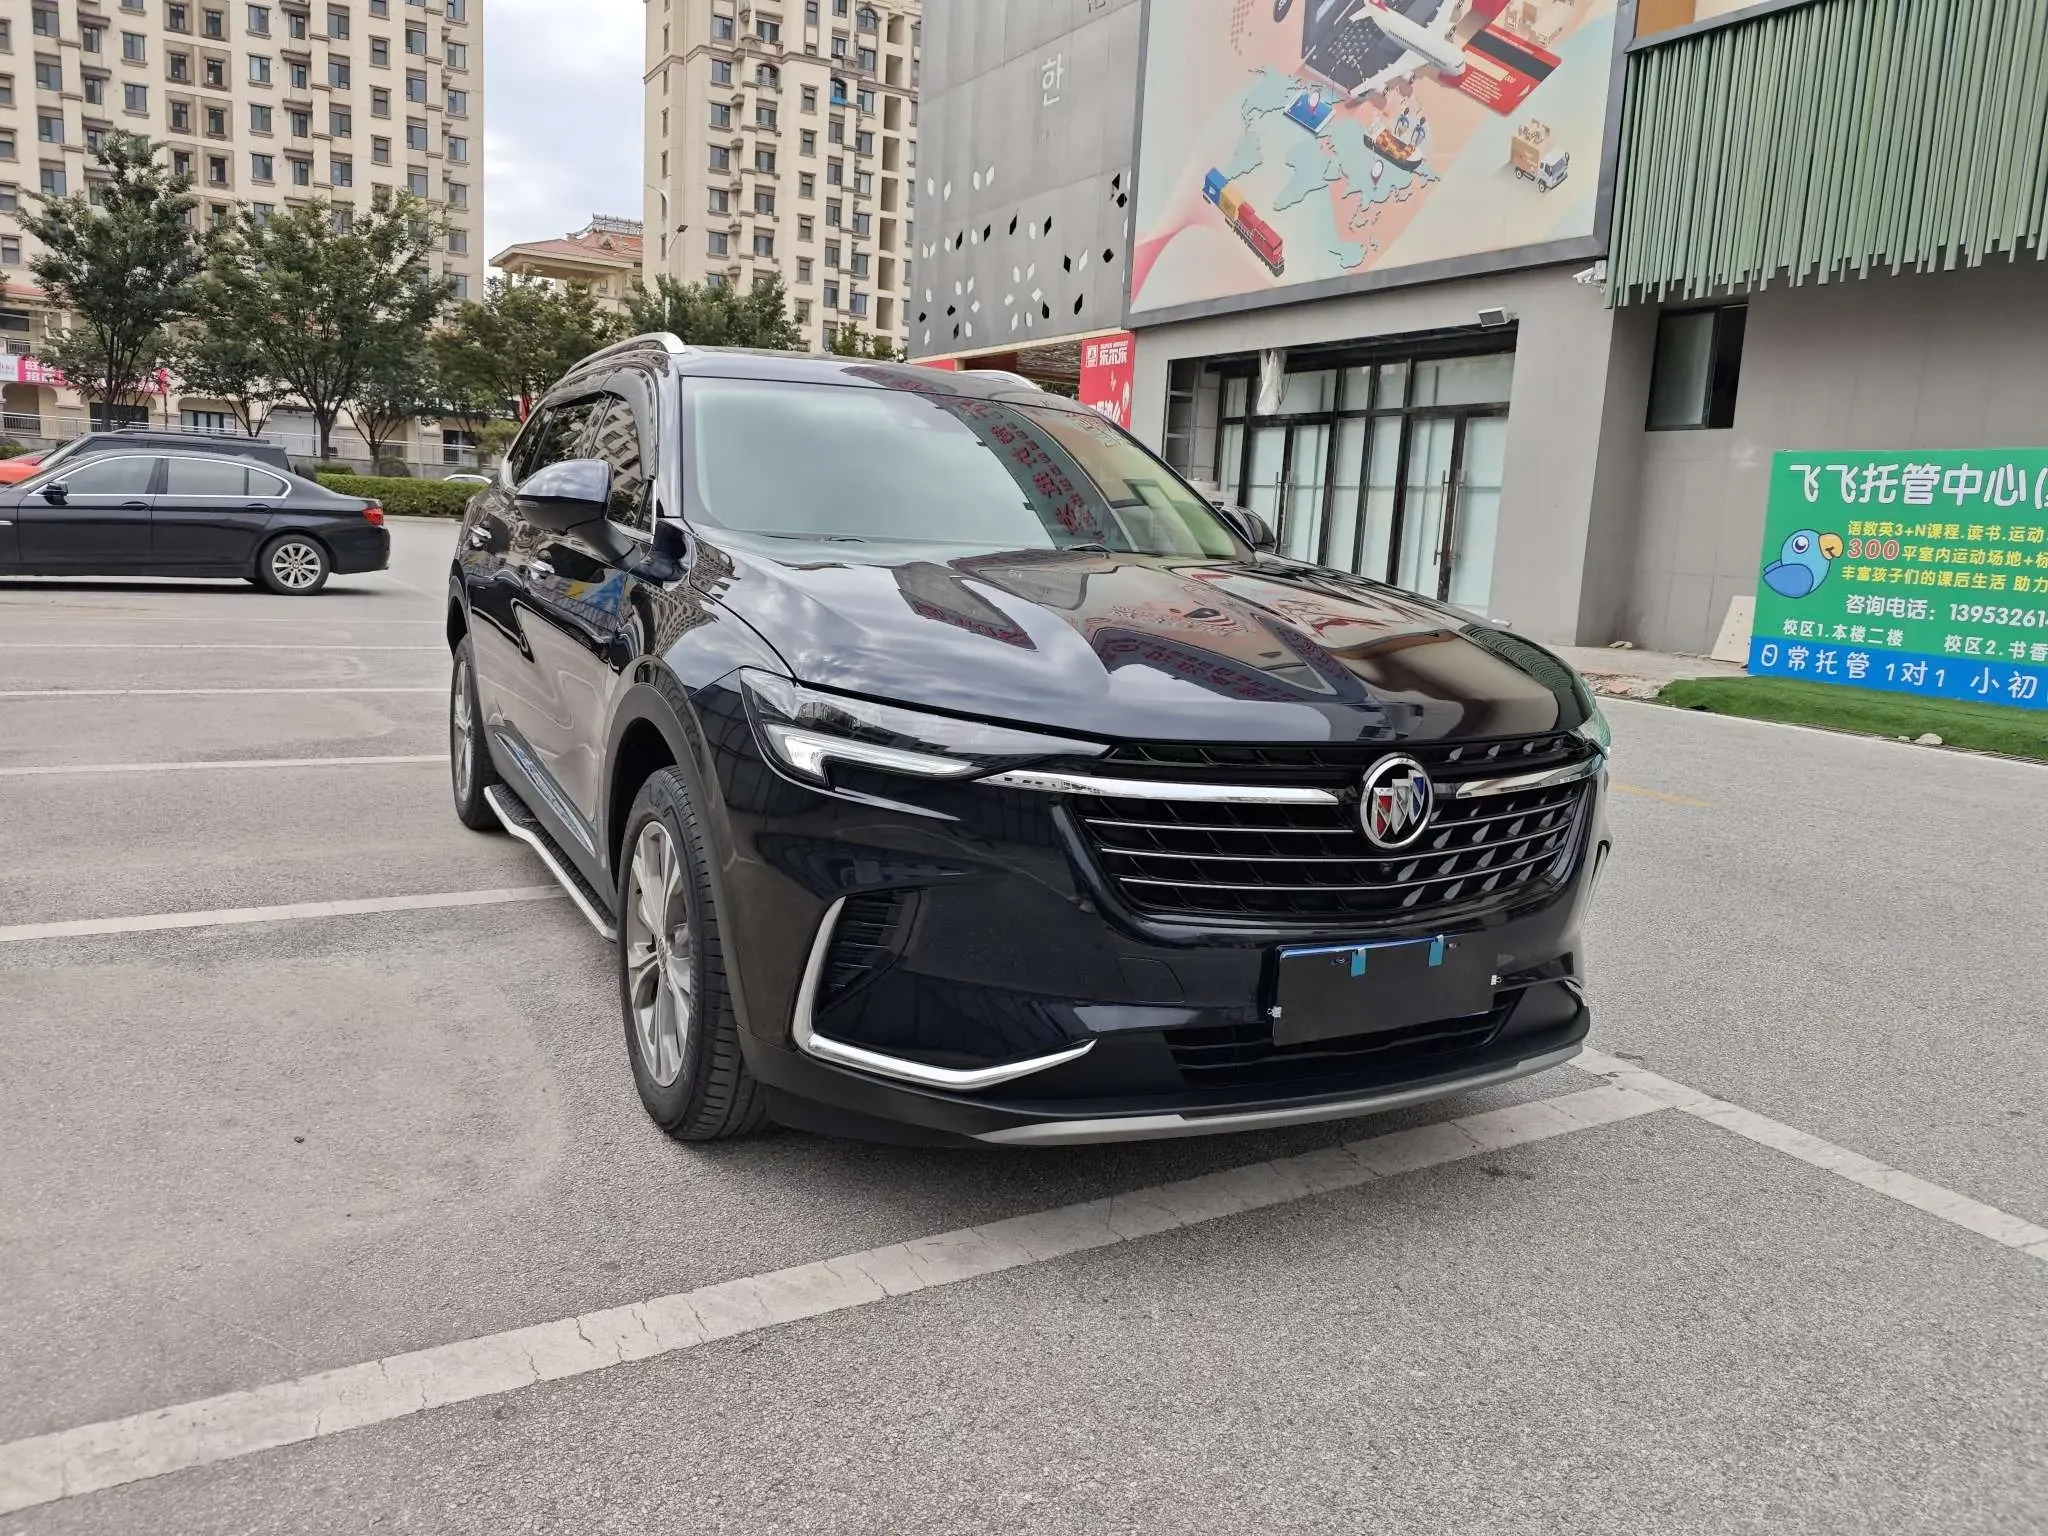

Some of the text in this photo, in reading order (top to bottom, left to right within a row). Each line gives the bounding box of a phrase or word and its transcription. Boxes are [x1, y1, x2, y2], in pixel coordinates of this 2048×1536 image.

[1041, 53, 1065, 107] 한
[1790, 462, 2048, 509] 飞飞托管中心(
[1949, 603, 2048, 628] 13953261
